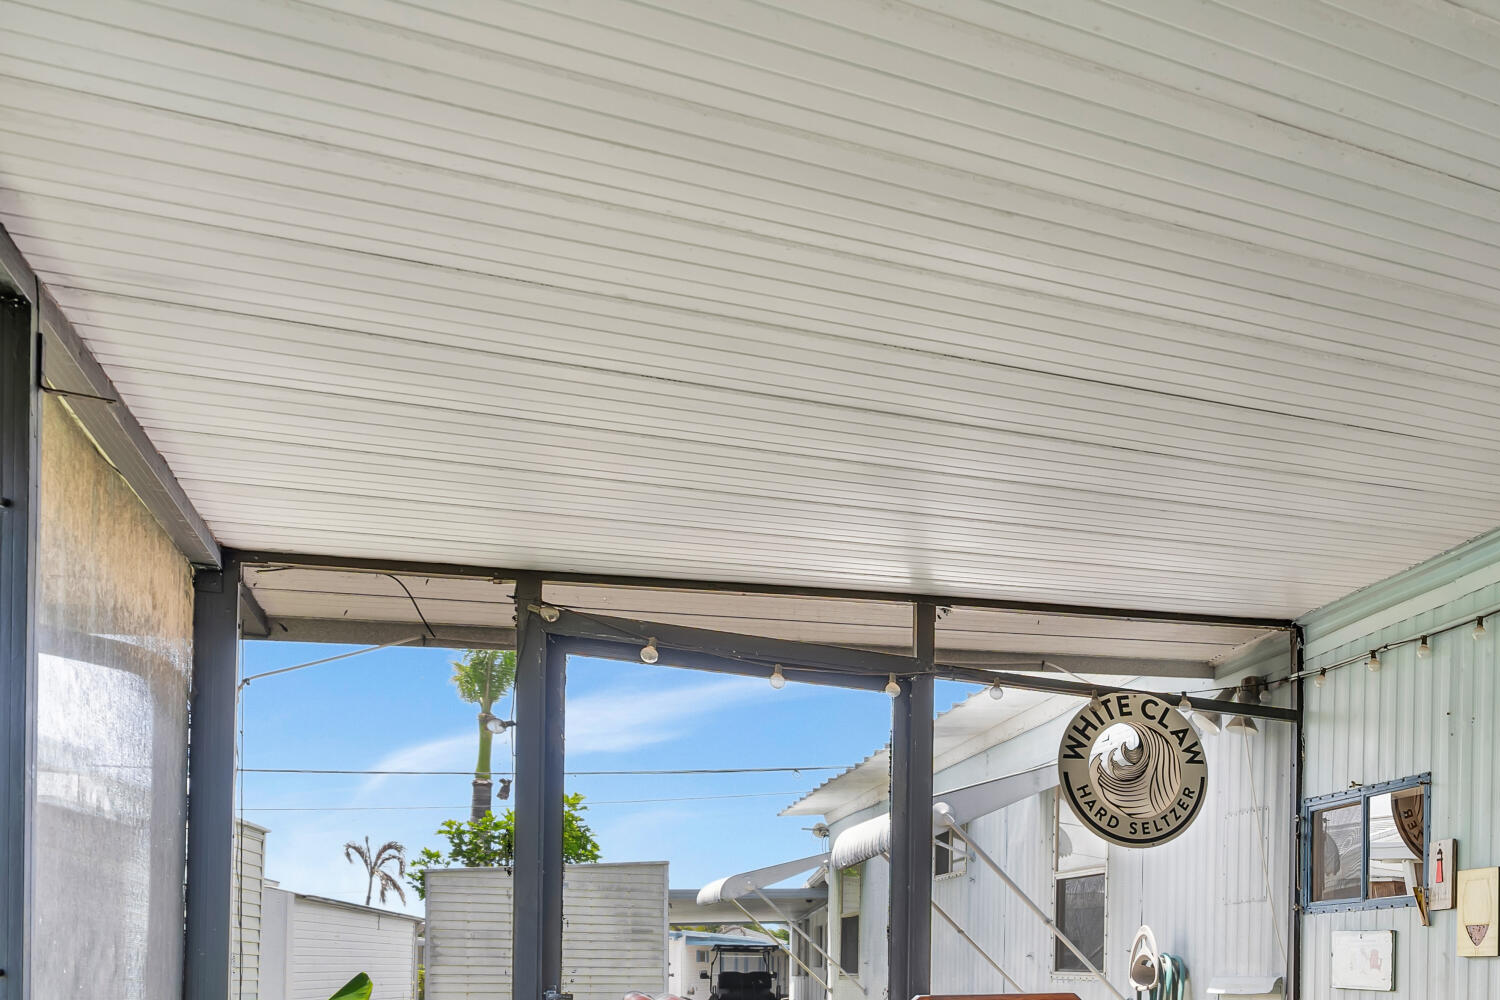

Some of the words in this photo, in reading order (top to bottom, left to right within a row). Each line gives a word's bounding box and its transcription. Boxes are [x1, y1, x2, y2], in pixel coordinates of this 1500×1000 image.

[1063, 695, 1133, 760] WHITE
[1141, 699, 1204, 765] CLAW
[1076, 784, 1120, 829] HARD
[1129, 786, 1196, 835] SELTZER
